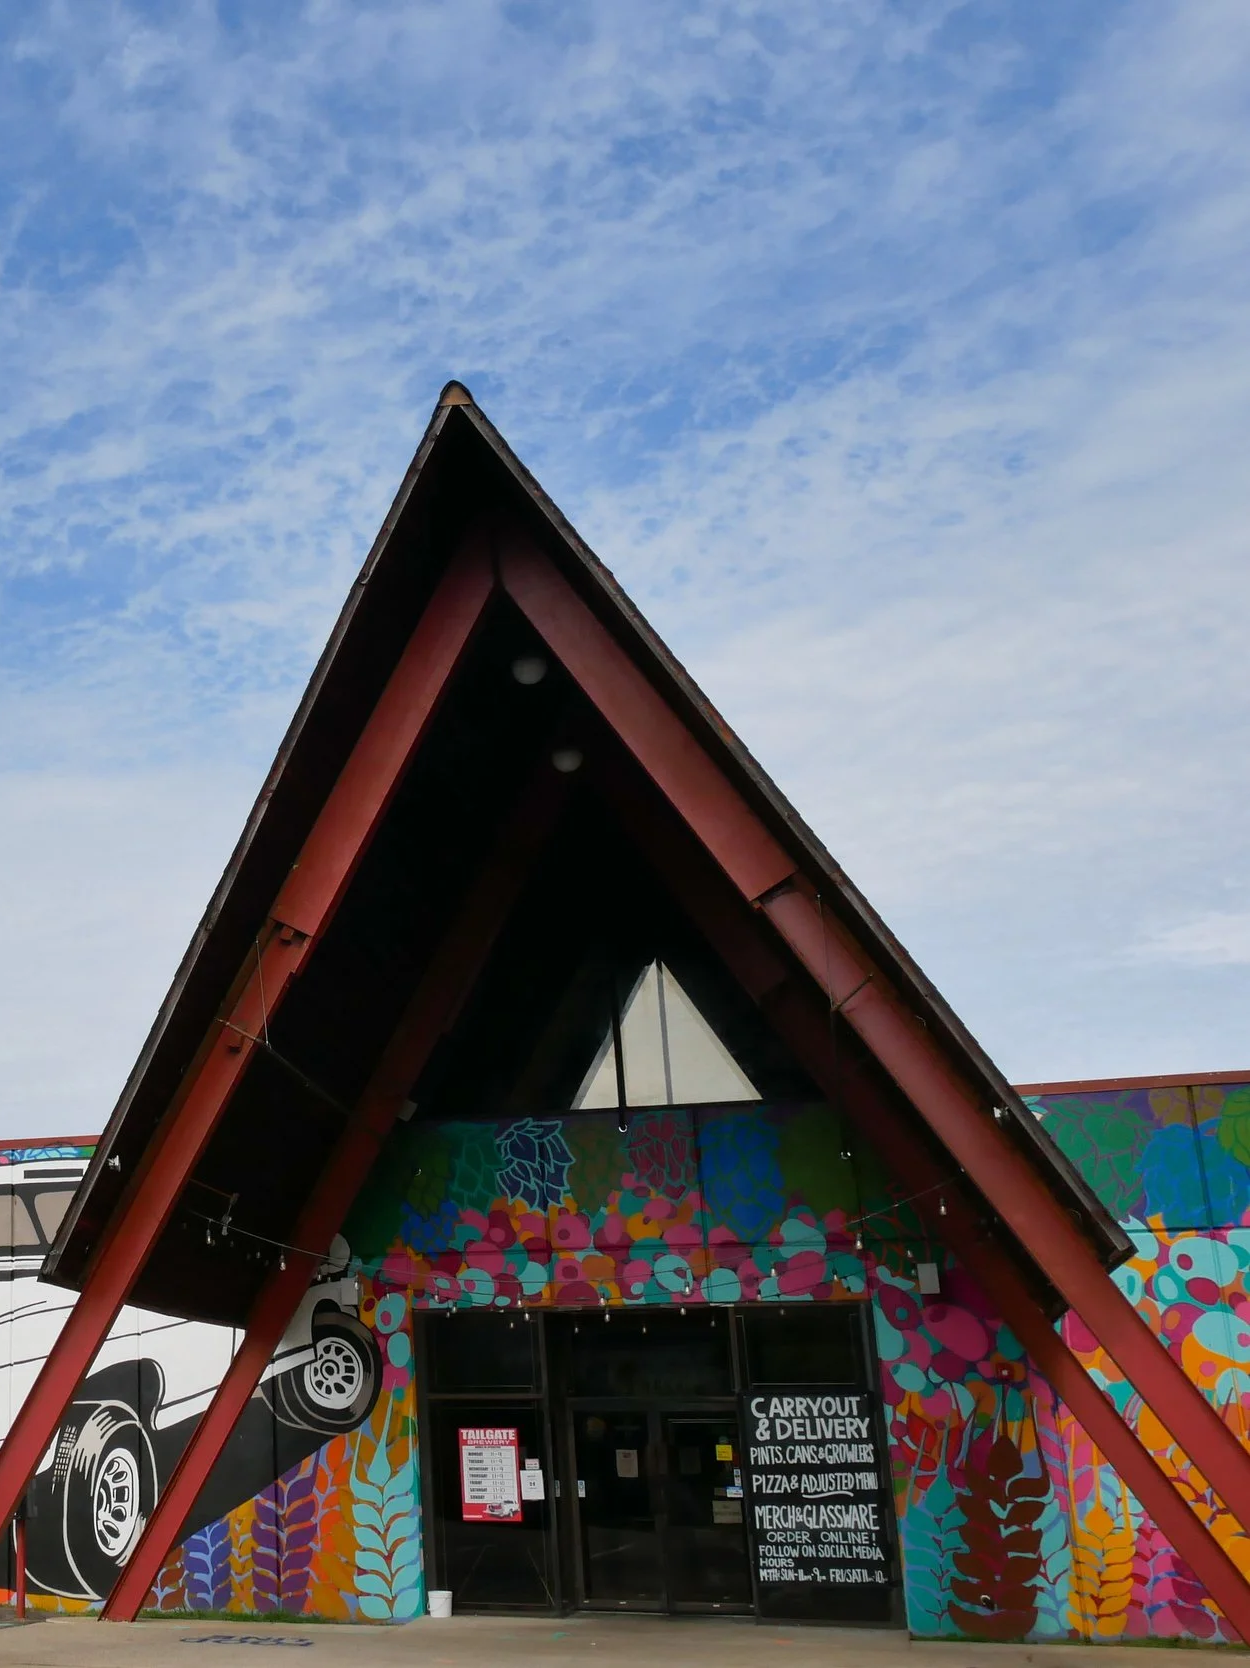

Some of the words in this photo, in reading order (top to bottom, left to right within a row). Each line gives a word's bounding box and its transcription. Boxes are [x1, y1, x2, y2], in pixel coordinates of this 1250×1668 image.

[750, 1396, 861, 1419] CARRYOUT
[460, 1429, 516, 1440] TAILGATE
[755, 1418, 771, 1441] &
[775, 1417, 870, 1440] DELIVERY
[825, 1443, 874, 1464] GROWLERS
[752, 1474, 791, 1494] PIZZA
[800, 1473, 854, 1493] ADJUSTED
[854, 1472, 878, 1490] MENU
[803, 1504, 880, 1530] GLASSWARE
[766, 1531, 812, 1543] ORDER
[820, 1531, 877, 1546] ONLINE!
[758, 1545, 800, 1558] FOLLOW
[801, 1545, 817, 1558] ON
[818, 1544, 853, 1558] SOCIAL
[852, 1545, 885, 1561] MEDIA
[759, 1558, 795, 1568] HOURS
